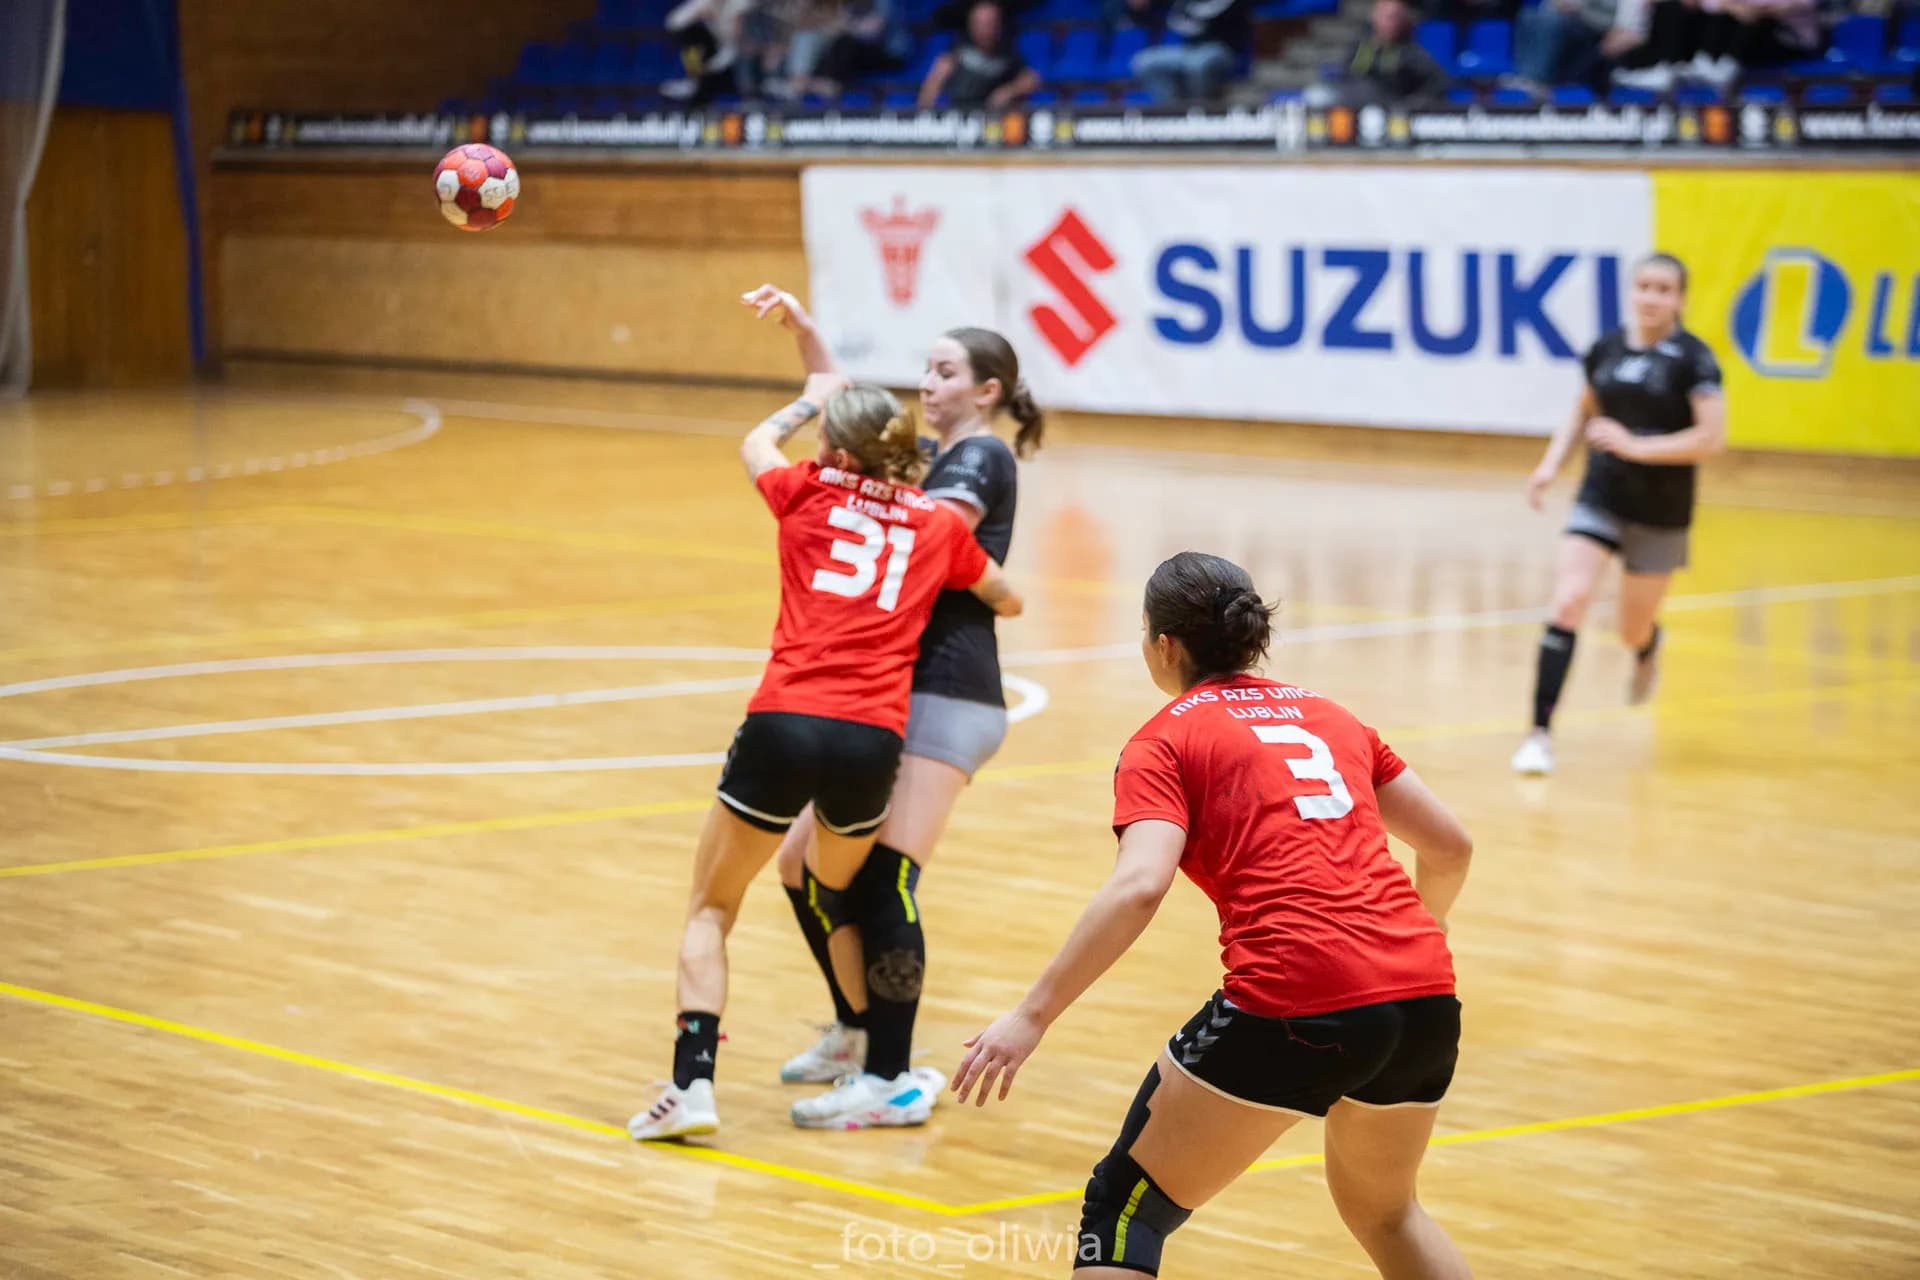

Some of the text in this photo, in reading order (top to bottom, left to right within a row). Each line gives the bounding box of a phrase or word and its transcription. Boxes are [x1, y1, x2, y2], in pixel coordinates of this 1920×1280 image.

[1152, 244, 1623, 358] SUZUKI
[819, 466, 859, 490] MKS
[846, 493, 908, 522] LUBLIN
[812, 505, 916, 612] 31
[1169, 690, 1219, 717] MKS
[1221, 687, 1265, 702] AZS
[1226, 705, 1304, 720] LUBLIN
[1249, 723, 1354, 820] 3
